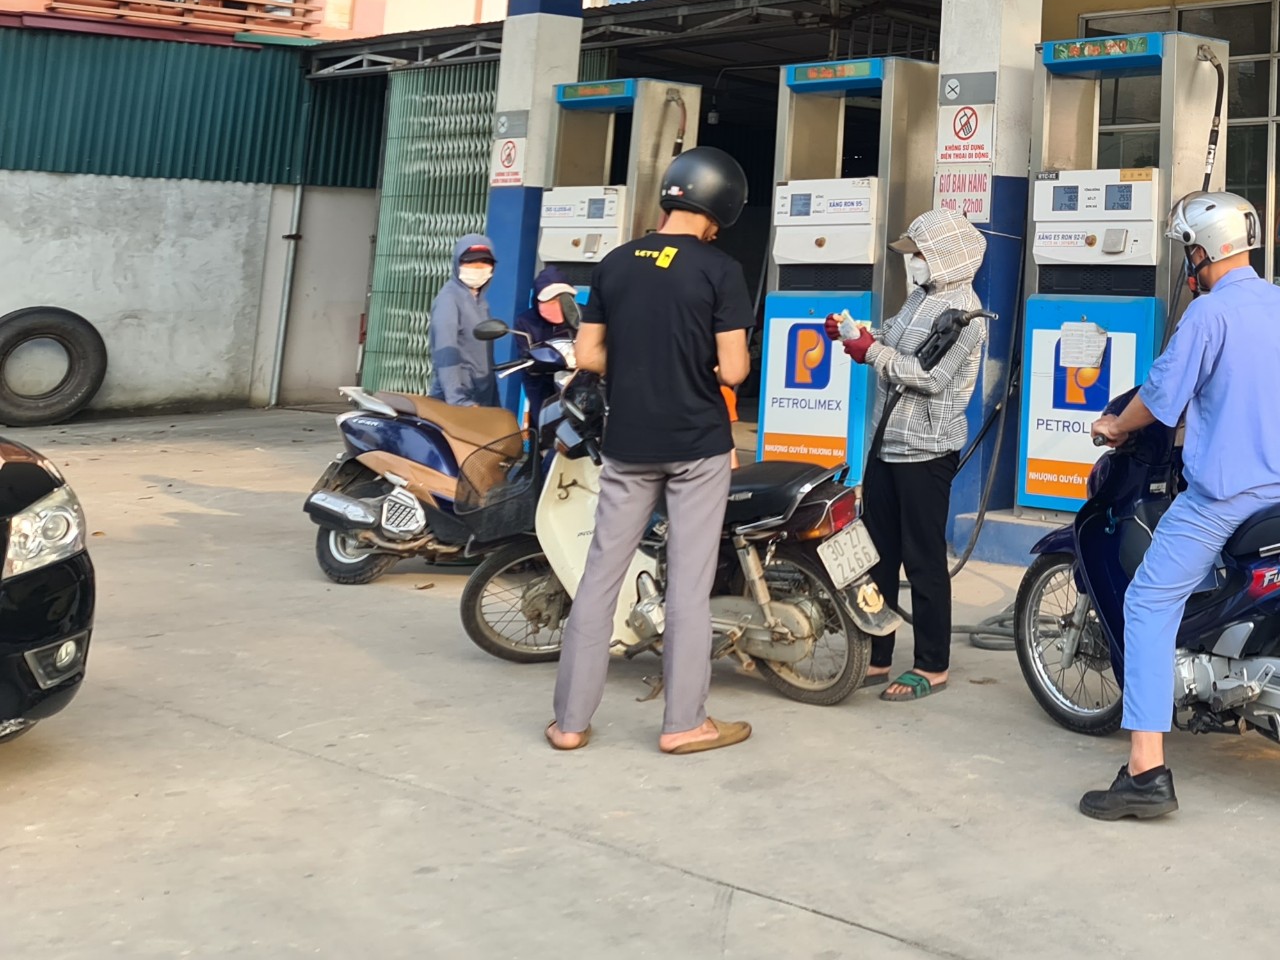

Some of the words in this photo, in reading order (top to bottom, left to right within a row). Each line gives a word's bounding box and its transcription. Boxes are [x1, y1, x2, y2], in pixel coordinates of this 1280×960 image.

[945, 143, 962, 151] KHÔNG
[963, 198, 983, 213] 22h00
[1061, 233, 1073, 241] RON
[771, 397, 842, 411] PETROLIMEX
[1036, 418, 1090, 434] PETROL
[1029, 472, 1057, 483] NHƯỢNG
[1059, 473, 1083, 485] QUYỀN
[837, 546, 872, 582] 2466
